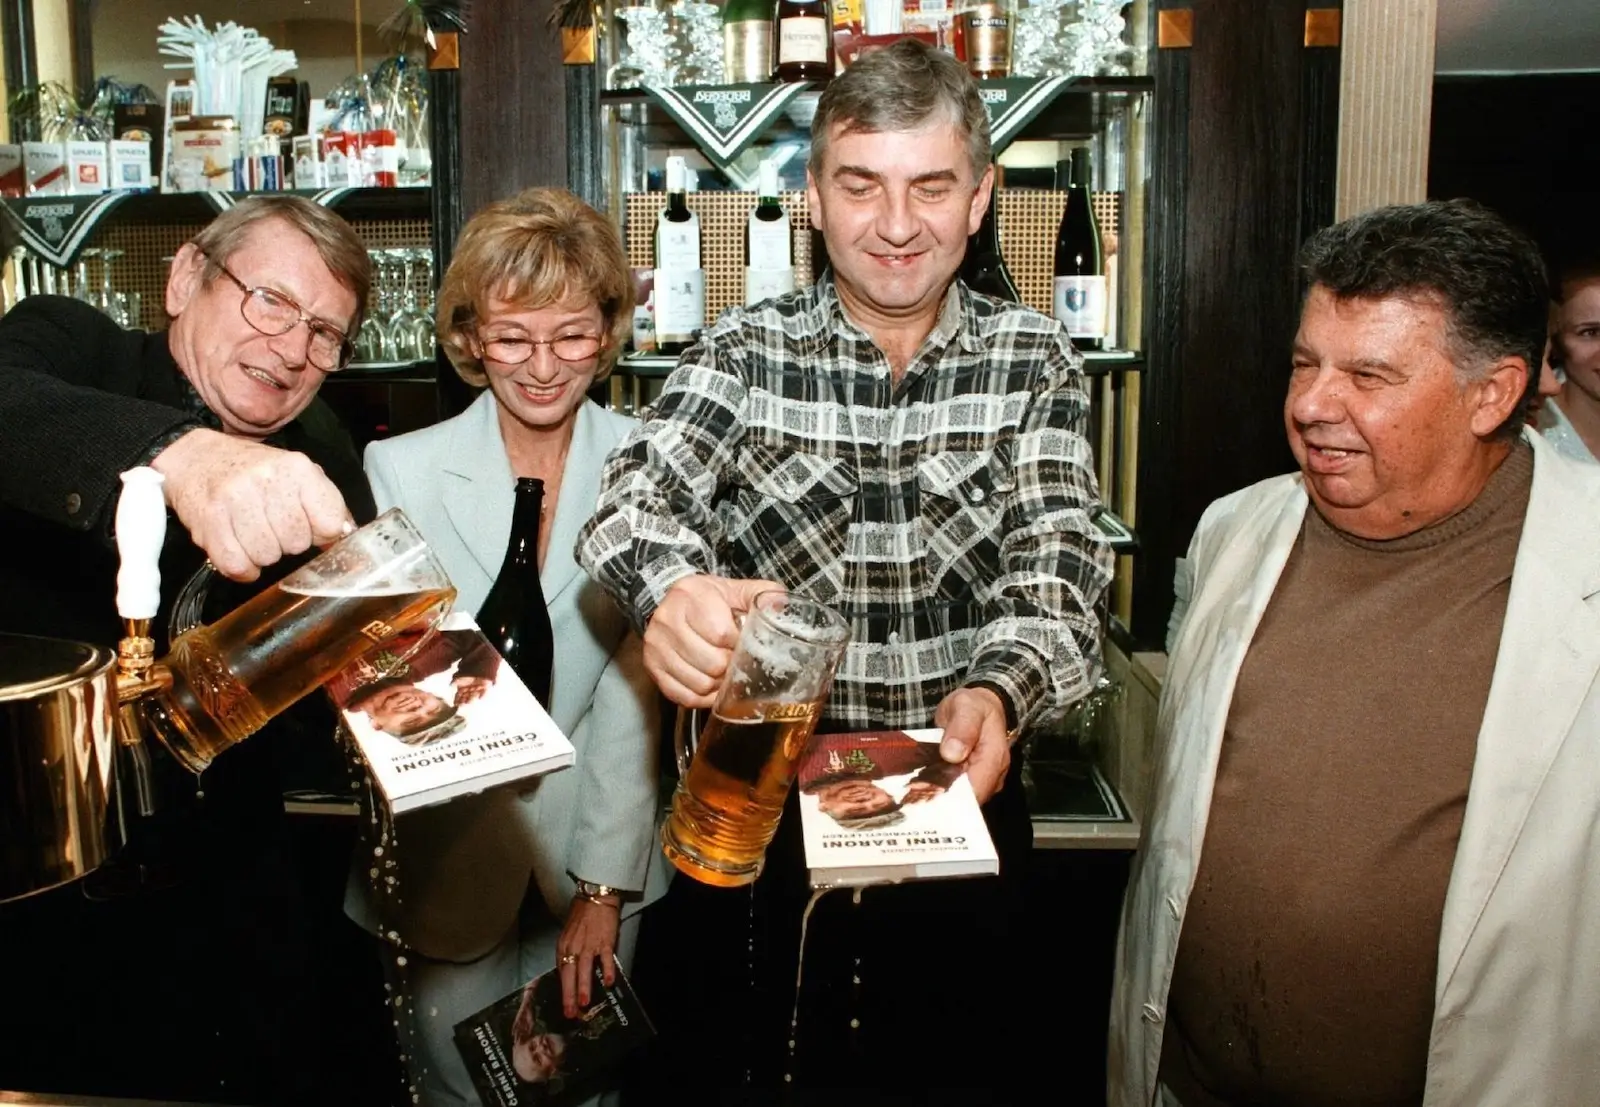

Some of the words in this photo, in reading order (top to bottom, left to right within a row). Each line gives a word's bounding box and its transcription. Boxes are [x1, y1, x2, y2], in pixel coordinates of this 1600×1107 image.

[972, 19, 1007, 27] MATELL
[479, 731, 538, 753] ČERNÍ
[395, 748, 472, 774] BARONI
[821, 838, 898, 849] BARONI
[906, 835, 966, 847] ČERNÍ
[473, 1026, 500, 1070] BARONI
